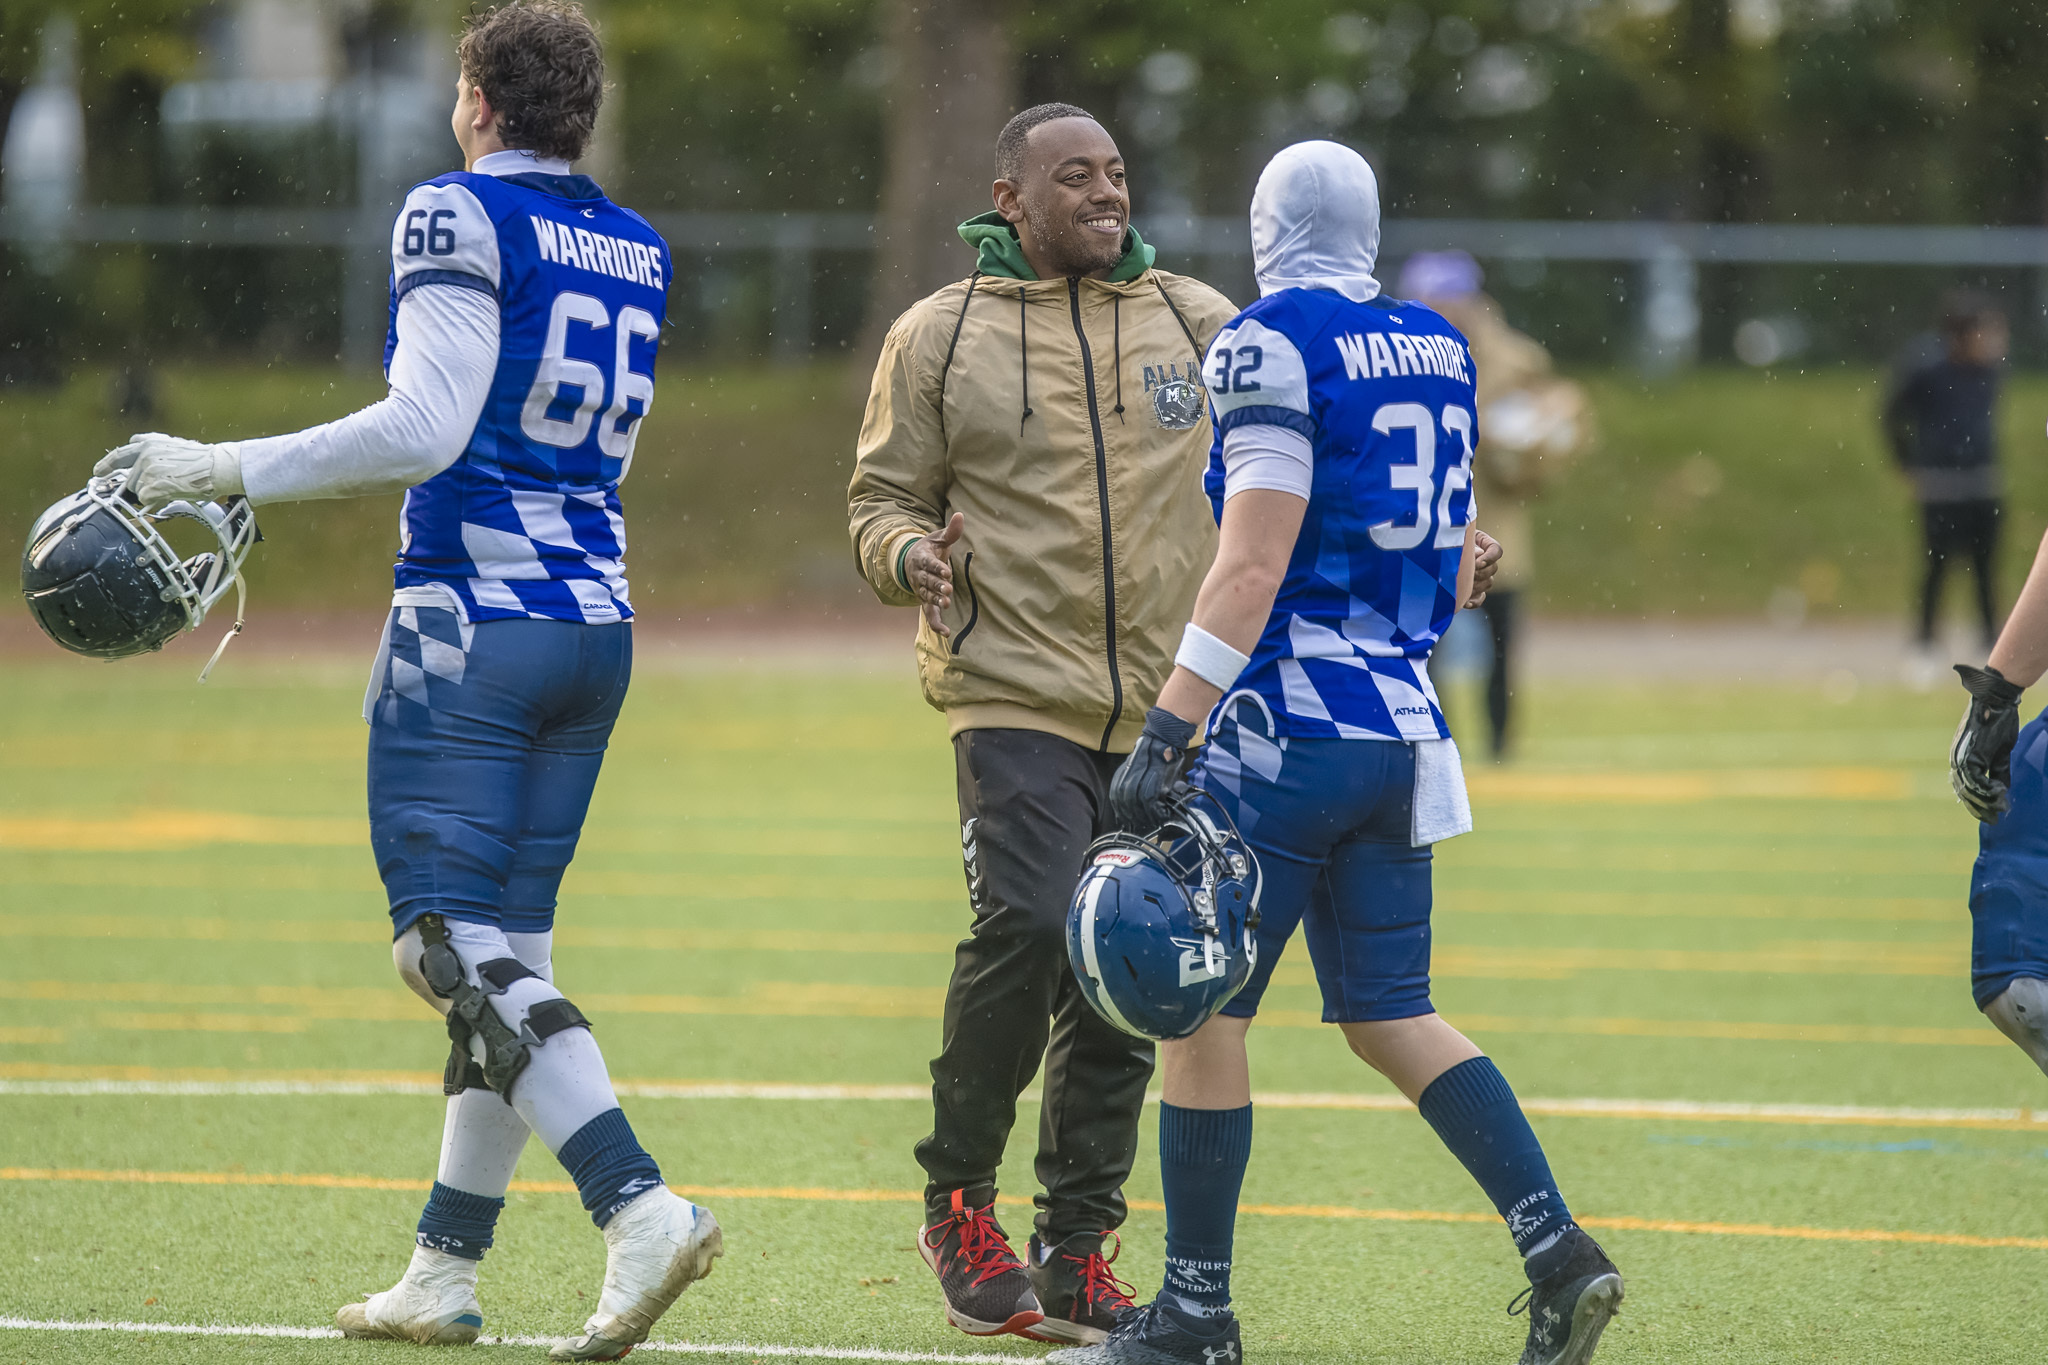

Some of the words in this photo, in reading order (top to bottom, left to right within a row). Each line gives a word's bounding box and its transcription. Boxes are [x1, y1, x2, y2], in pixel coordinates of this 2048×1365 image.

[402, 209, 457, 256] 66
[529, 213, 664, 292] WARRIORS
[520, 290, 660, 459] 66
[1212, 345, 1263, 395] 32
[1165, 387, 1181, 403] M
[1367, 401, 1473, 551] 32
[1394, 706, 1430, 716] ATHLEX
[1506, 1190, 1549, 1227] RRIORS
[1514, 1210, 1551, 1245] OTBALL
